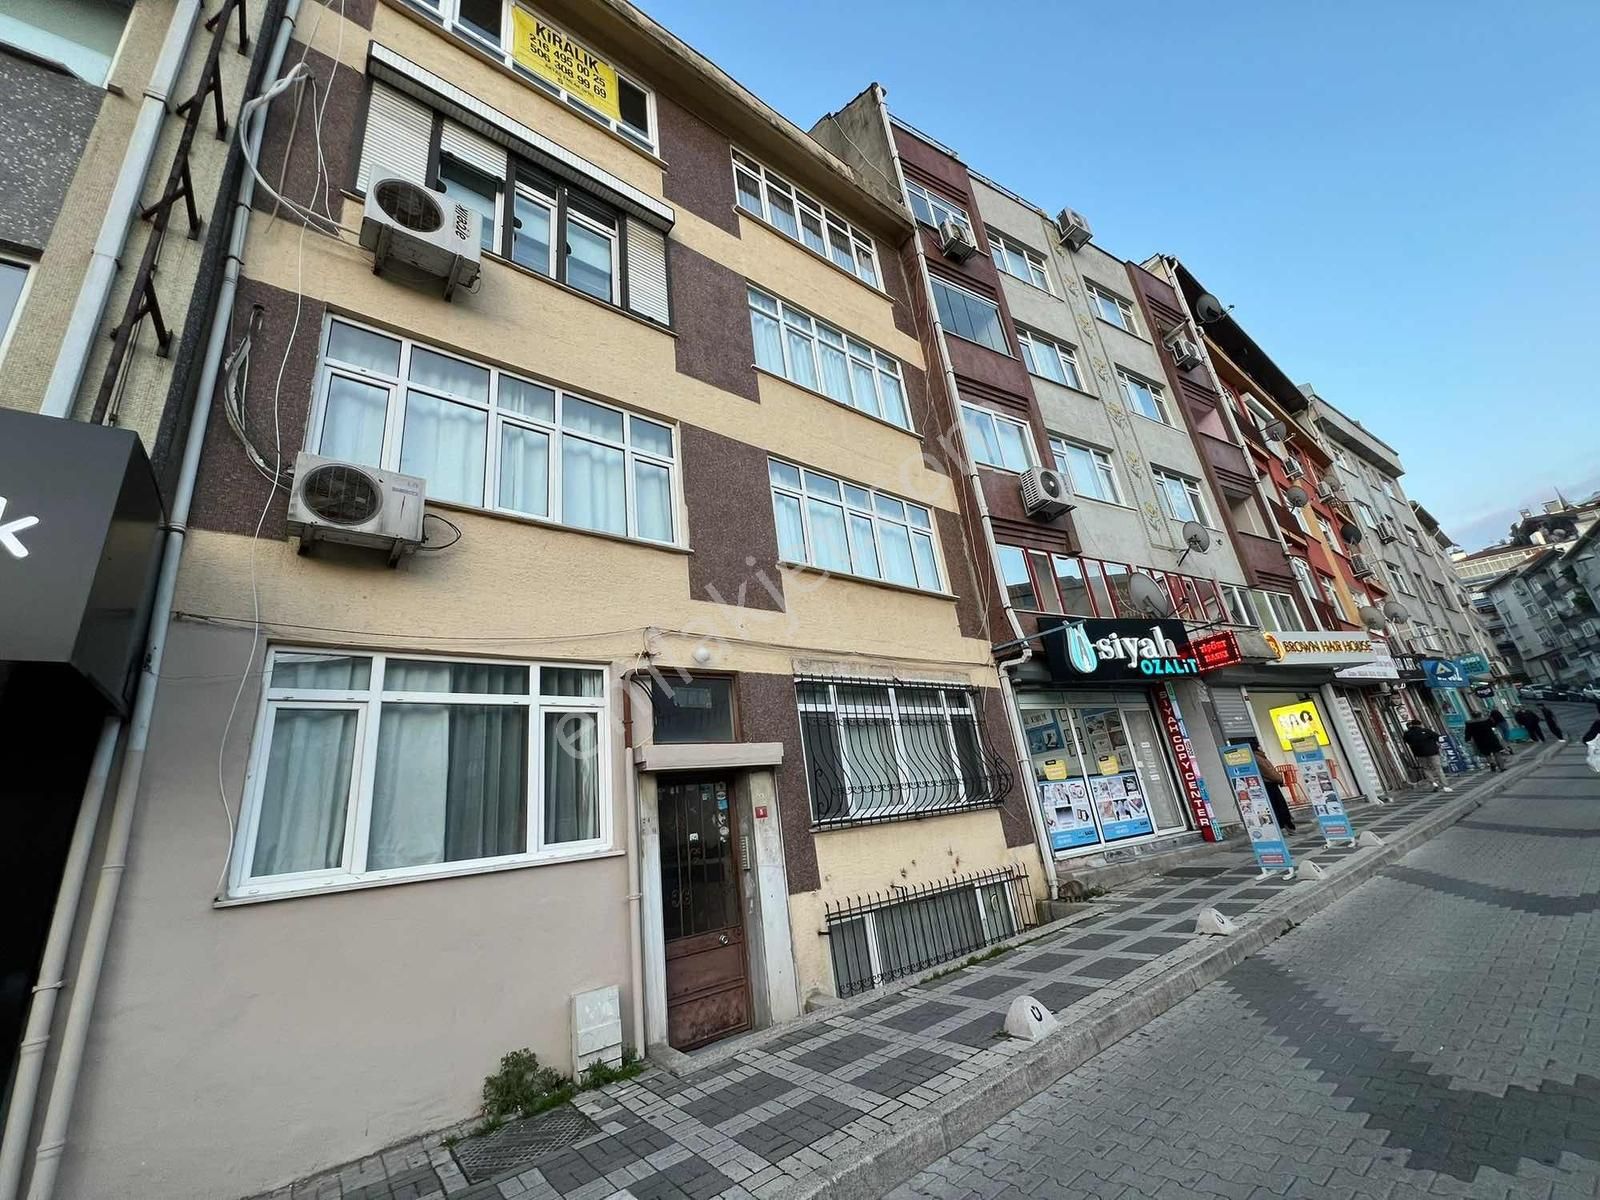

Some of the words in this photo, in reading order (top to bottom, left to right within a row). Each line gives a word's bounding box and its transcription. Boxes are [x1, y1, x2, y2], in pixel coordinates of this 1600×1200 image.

[529, 33, 550, 53] 216
[553, 50, 573, 68] 495
[576, 63, 590, 77] 00
[593, 73, 606, 88] 25
[530, 43, 551, 63] 506
[554, 60, 574, 78] 308
[576, 75, 591, 89] 99
[593, 84, 607, 99] 69
[1096, 626, 1181, 669] siyah
[1282, 640, 1320, 653] BROWN
[1321, 640, 1343, 653] HAIR
[1343, 640, 1374, 653] HOUSE
[1172, 735, 1190, 770] COPY
[1185, 772, 1211, 827] CENTER
